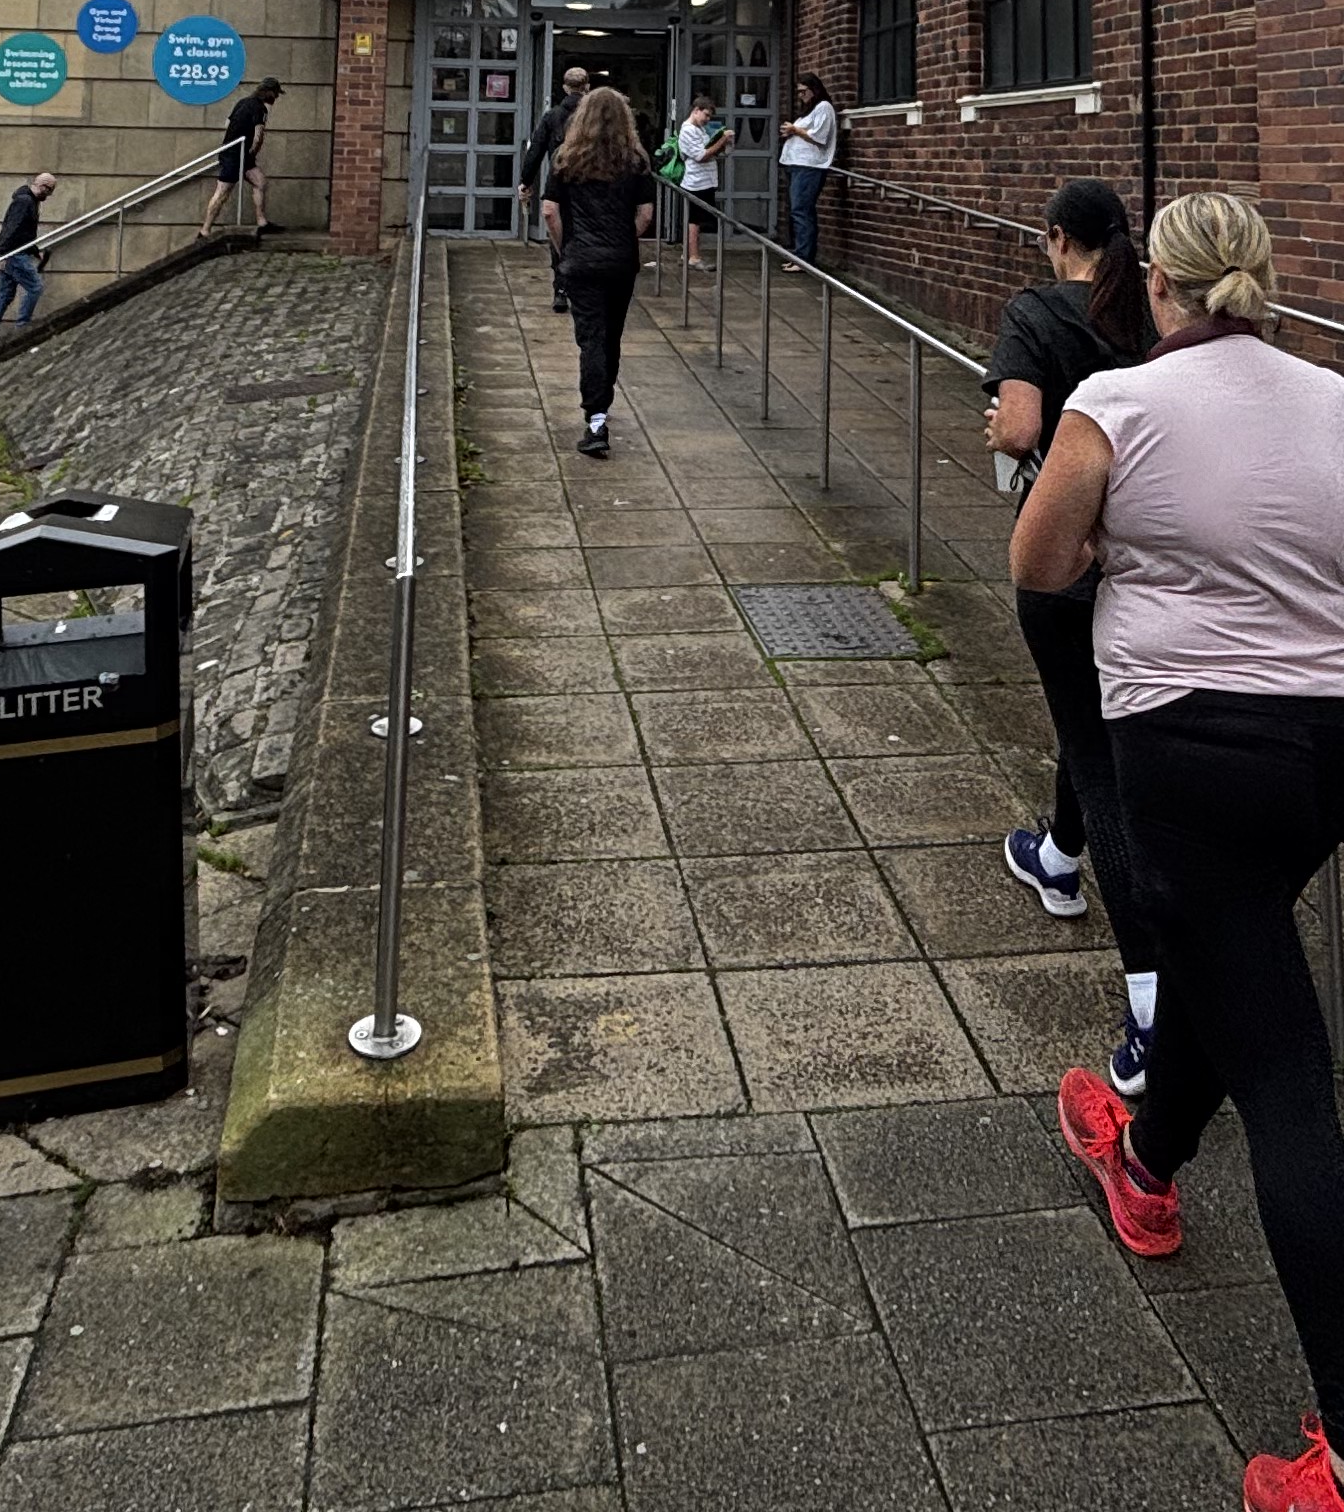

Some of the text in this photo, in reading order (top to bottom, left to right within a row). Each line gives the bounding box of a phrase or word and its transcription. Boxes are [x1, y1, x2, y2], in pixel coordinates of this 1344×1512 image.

[89, 7, 127, 17] Gym and
[93, 16, 122, 25] Virtual
[94, 25, 121, 34] Group
[92, 33, 122, 43] Cycling
[168, 33, 234, 47] Swim, gym
[5, 48, 56, 60] Swimming
[173, 46, 228, 58] & classes
[3, 59, 56, 68] lessons for
[13, 71, 37, 80] ages
[39, 70, 59, 80] and
[169, 64, 230, 80] £28.95
[9, 79, 47, 88] abilities
[0, 686, 104, 719] LITTER
